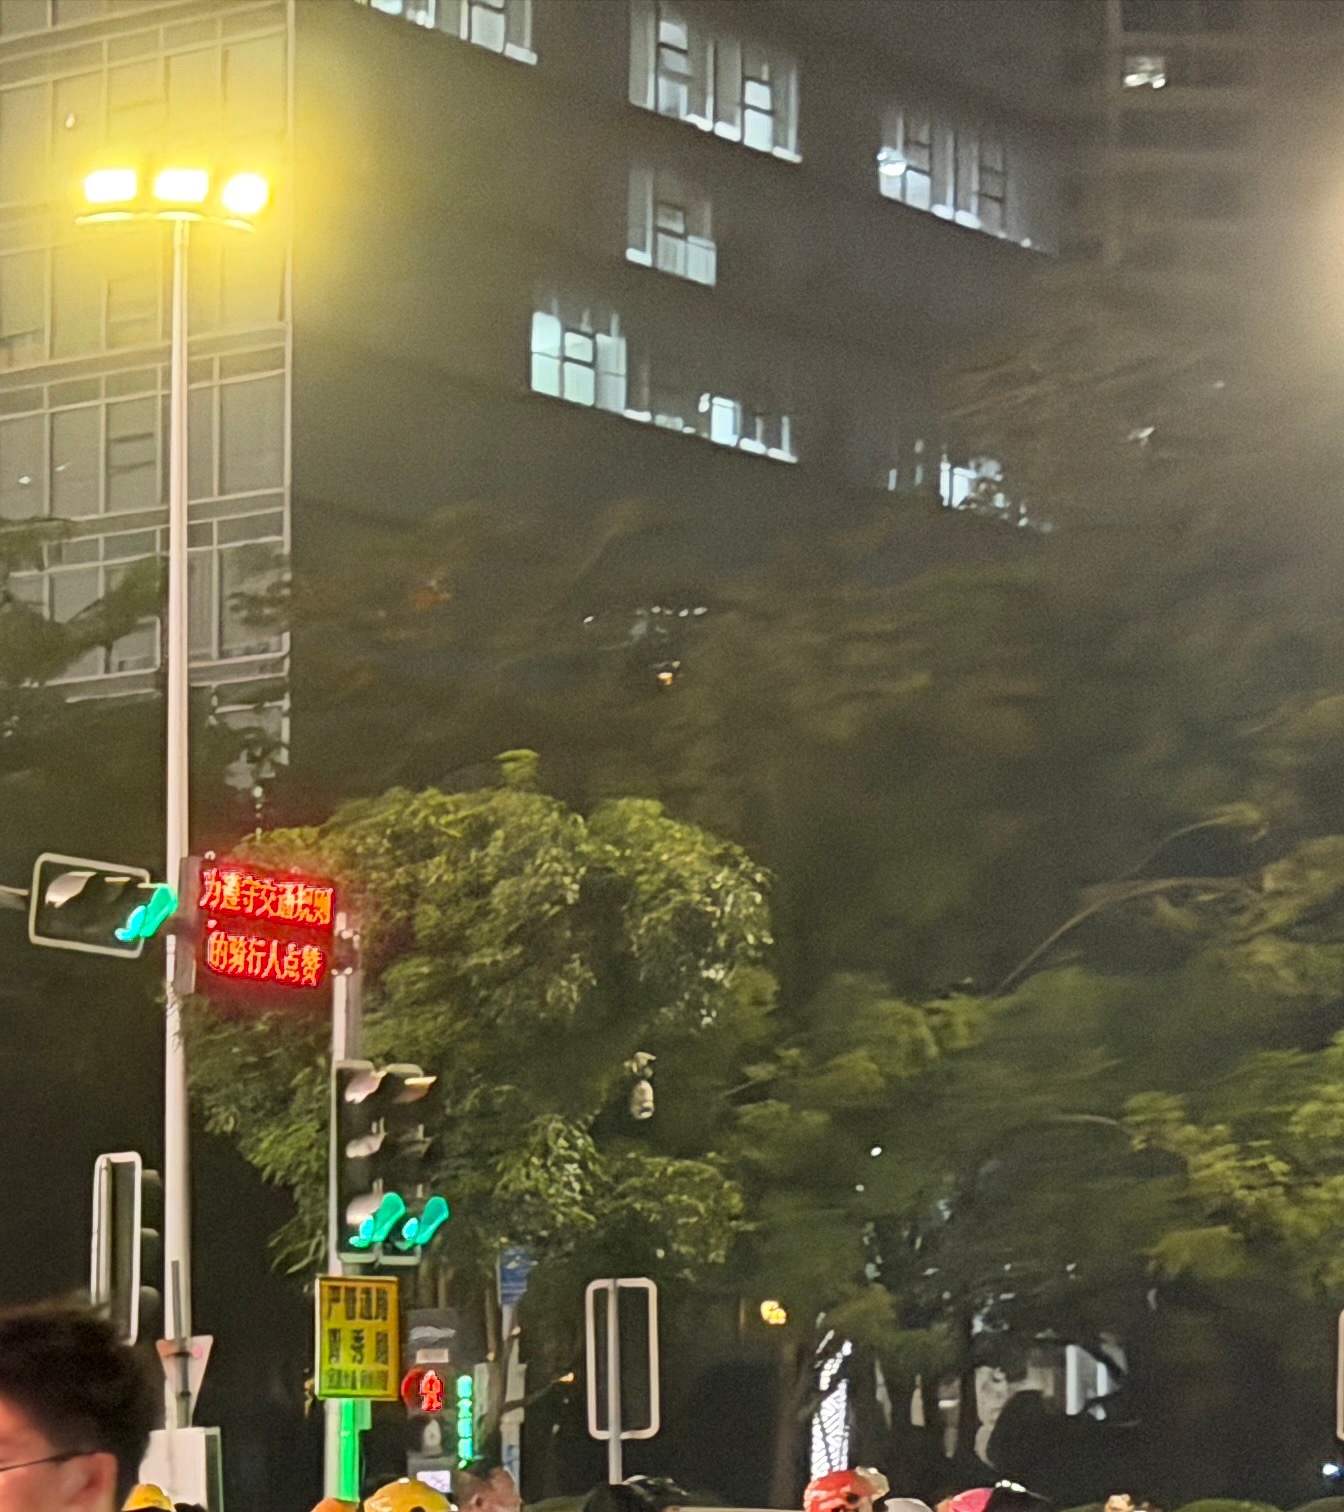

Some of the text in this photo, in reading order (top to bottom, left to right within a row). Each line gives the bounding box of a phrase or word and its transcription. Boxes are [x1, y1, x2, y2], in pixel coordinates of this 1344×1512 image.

[199, 868, 333, 925] 为遵守交通规则
[208, 931, 322, 985] 的骑行人点赞
